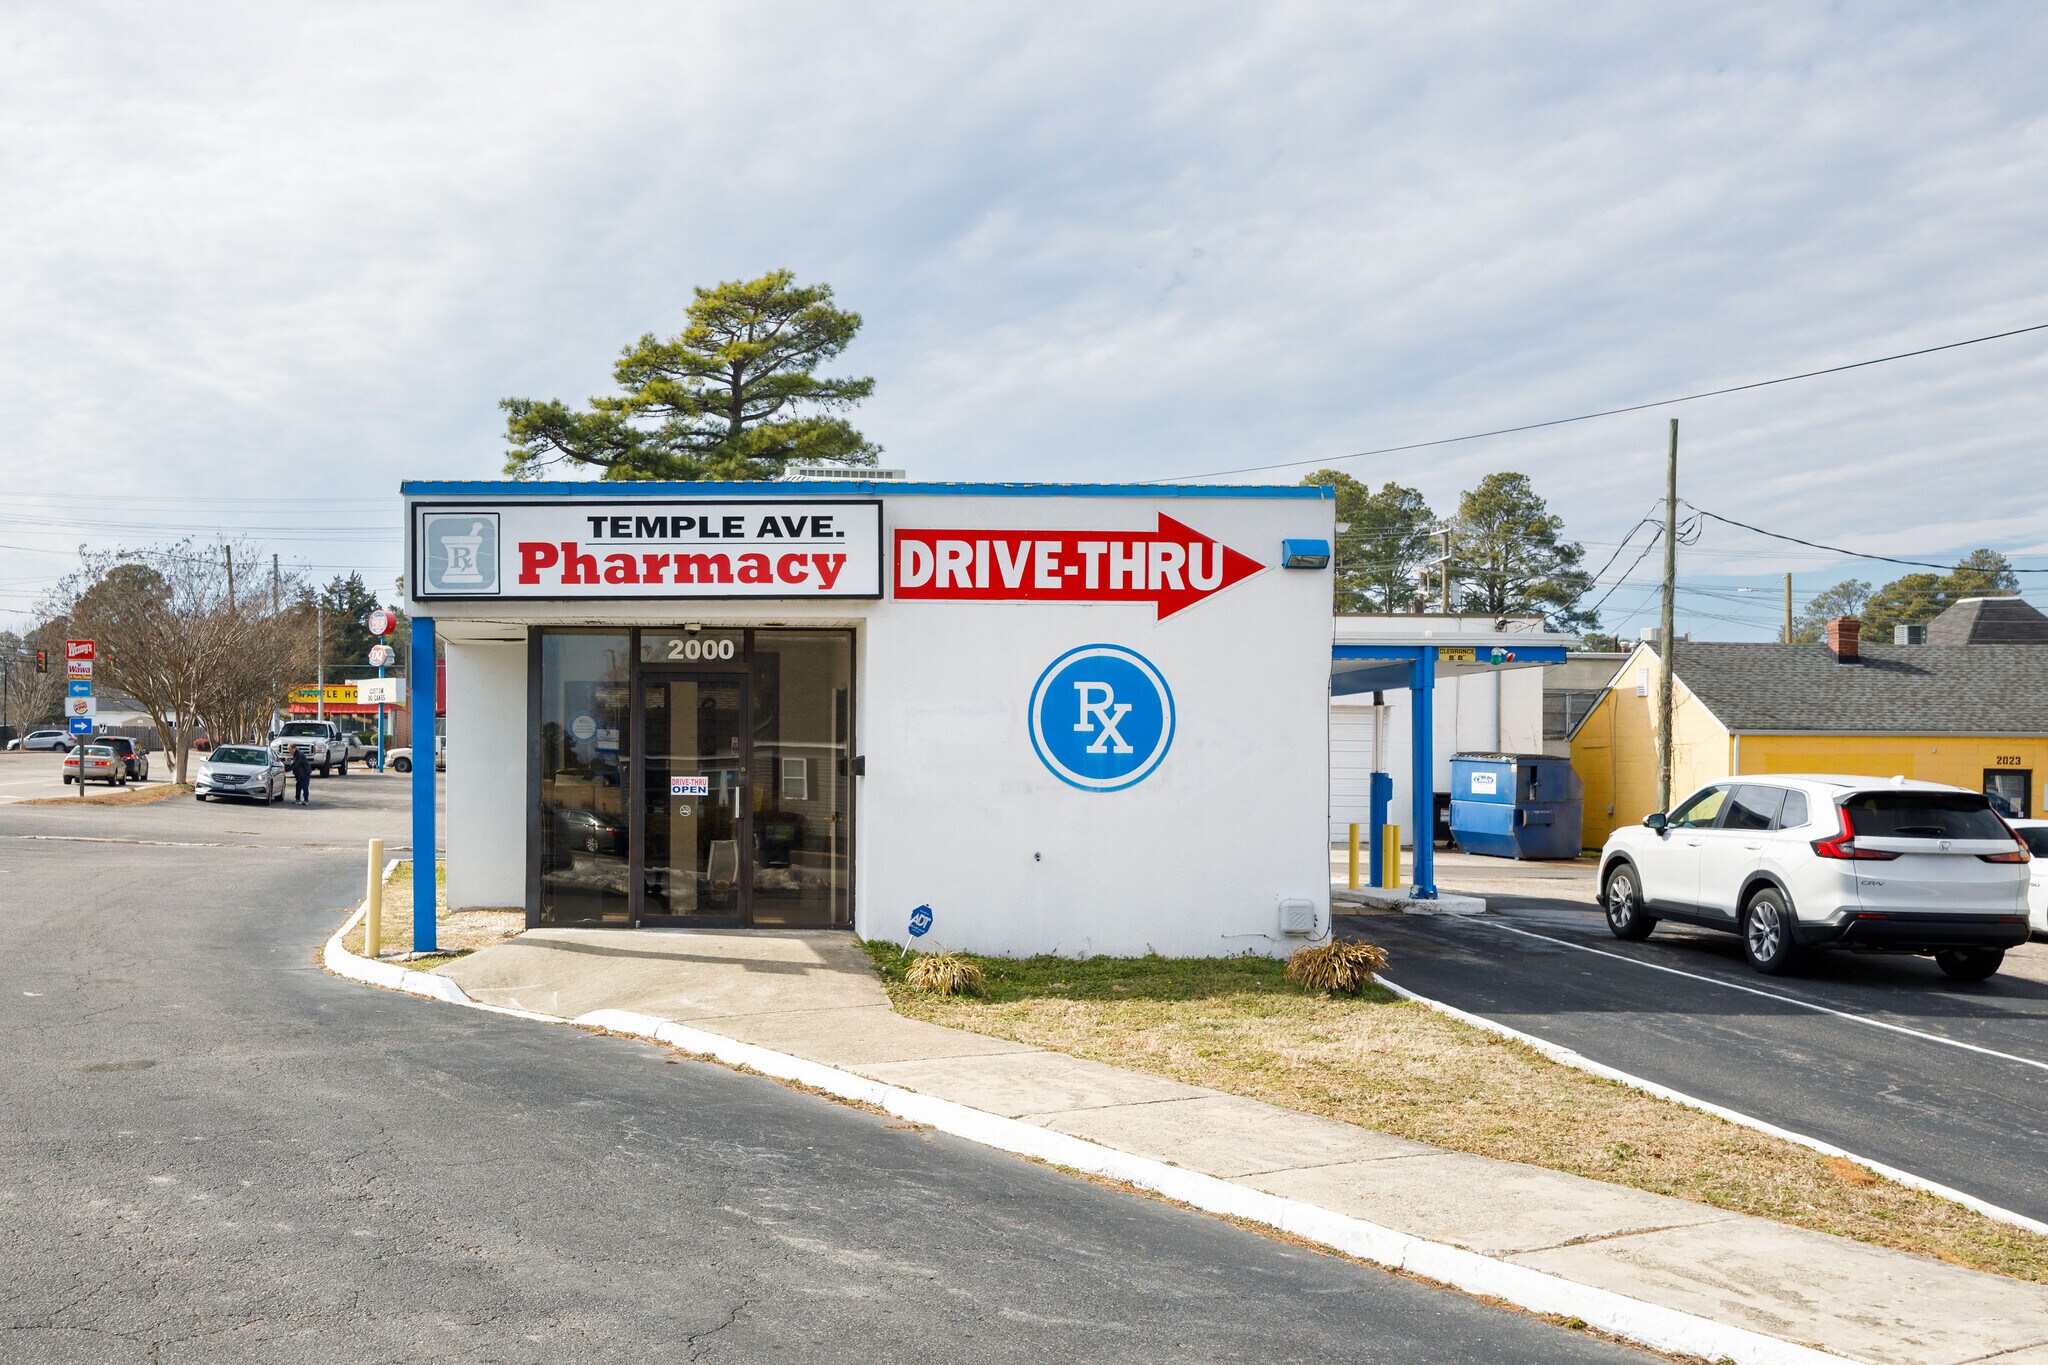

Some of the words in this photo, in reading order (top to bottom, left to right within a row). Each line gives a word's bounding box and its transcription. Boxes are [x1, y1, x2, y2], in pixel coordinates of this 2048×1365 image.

[587, 515, 745, 539] TEMPLE
[757, 515, 845, 539] AVE.
[518, 541, 847, 590] Pharmacy
[899, 539, 1224, 591] DRIVE-THRU
[668, 639, 735, 660] 2000
[69, 665, 91, 674] Wawa
[1996, 756, 2021, 765] 2023
[672, 778, 707, 786] DRIVE-THRU
[672, 785, 707, 794] OPEN
[909, 912, 932, 929] ADT
